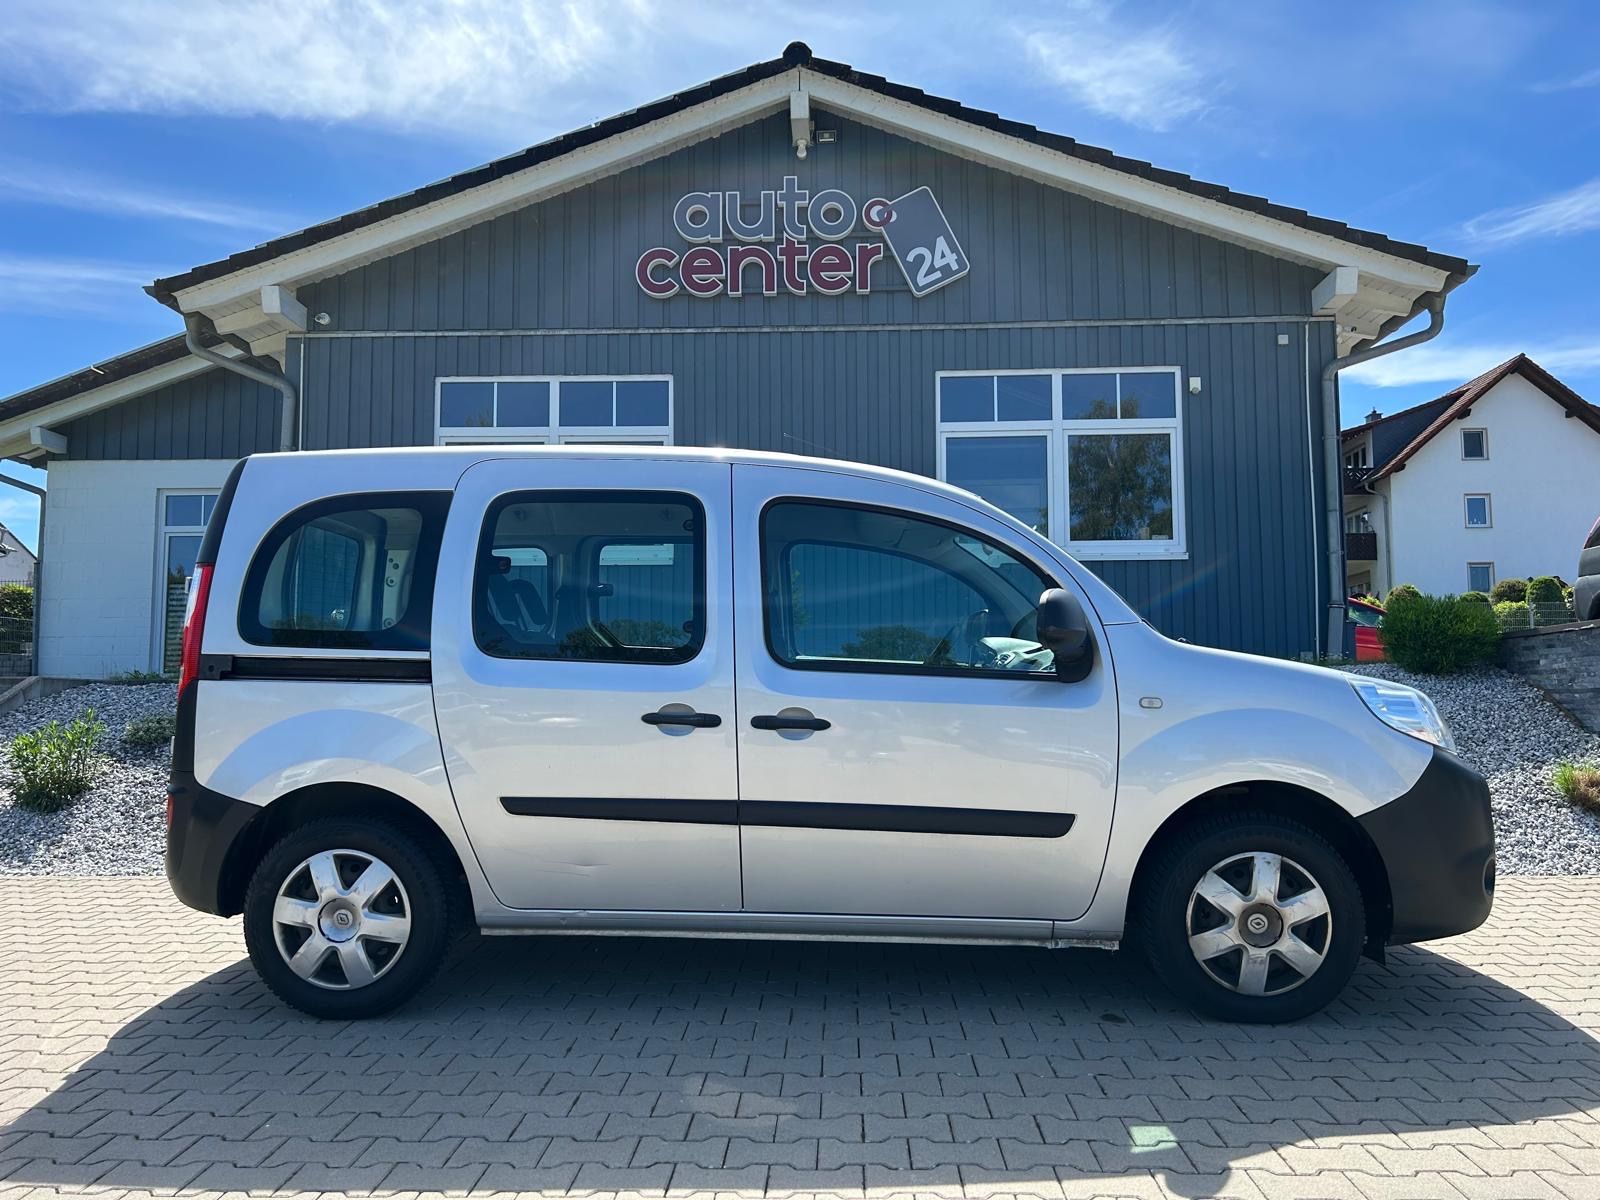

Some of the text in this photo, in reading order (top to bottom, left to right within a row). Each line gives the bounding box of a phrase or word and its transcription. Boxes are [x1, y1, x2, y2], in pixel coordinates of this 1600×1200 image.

[673, 175, 857, 243] auto
[635, 233, 884, 298] center
[905, 235, 959, 288] 24
